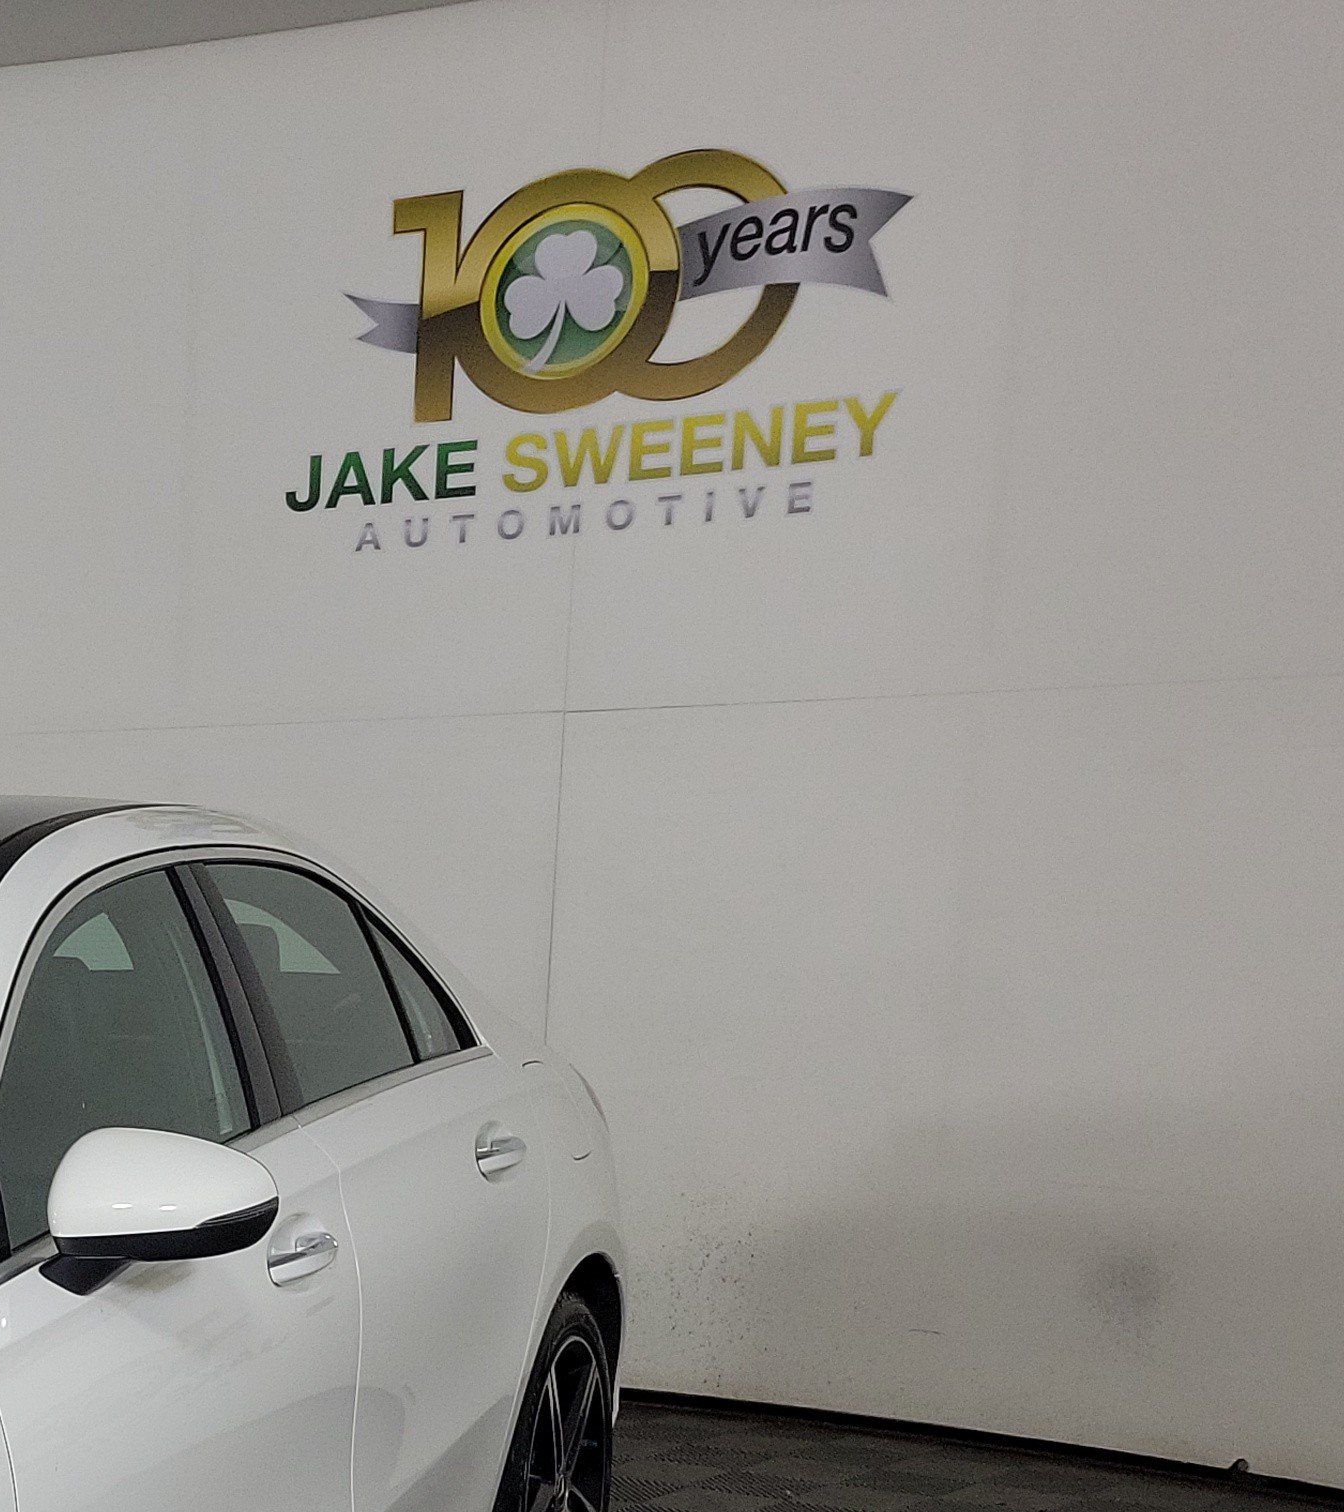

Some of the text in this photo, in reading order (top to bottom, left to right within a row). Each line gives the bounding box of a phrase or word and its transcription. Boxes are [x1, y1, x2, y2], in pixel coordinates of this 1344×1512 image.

[392, 148, 858, 422] 100 years
[284, 392, 898, 512] JAKE SWEENEY
[355, 481, 814, 552] AUTOMOTIVE
